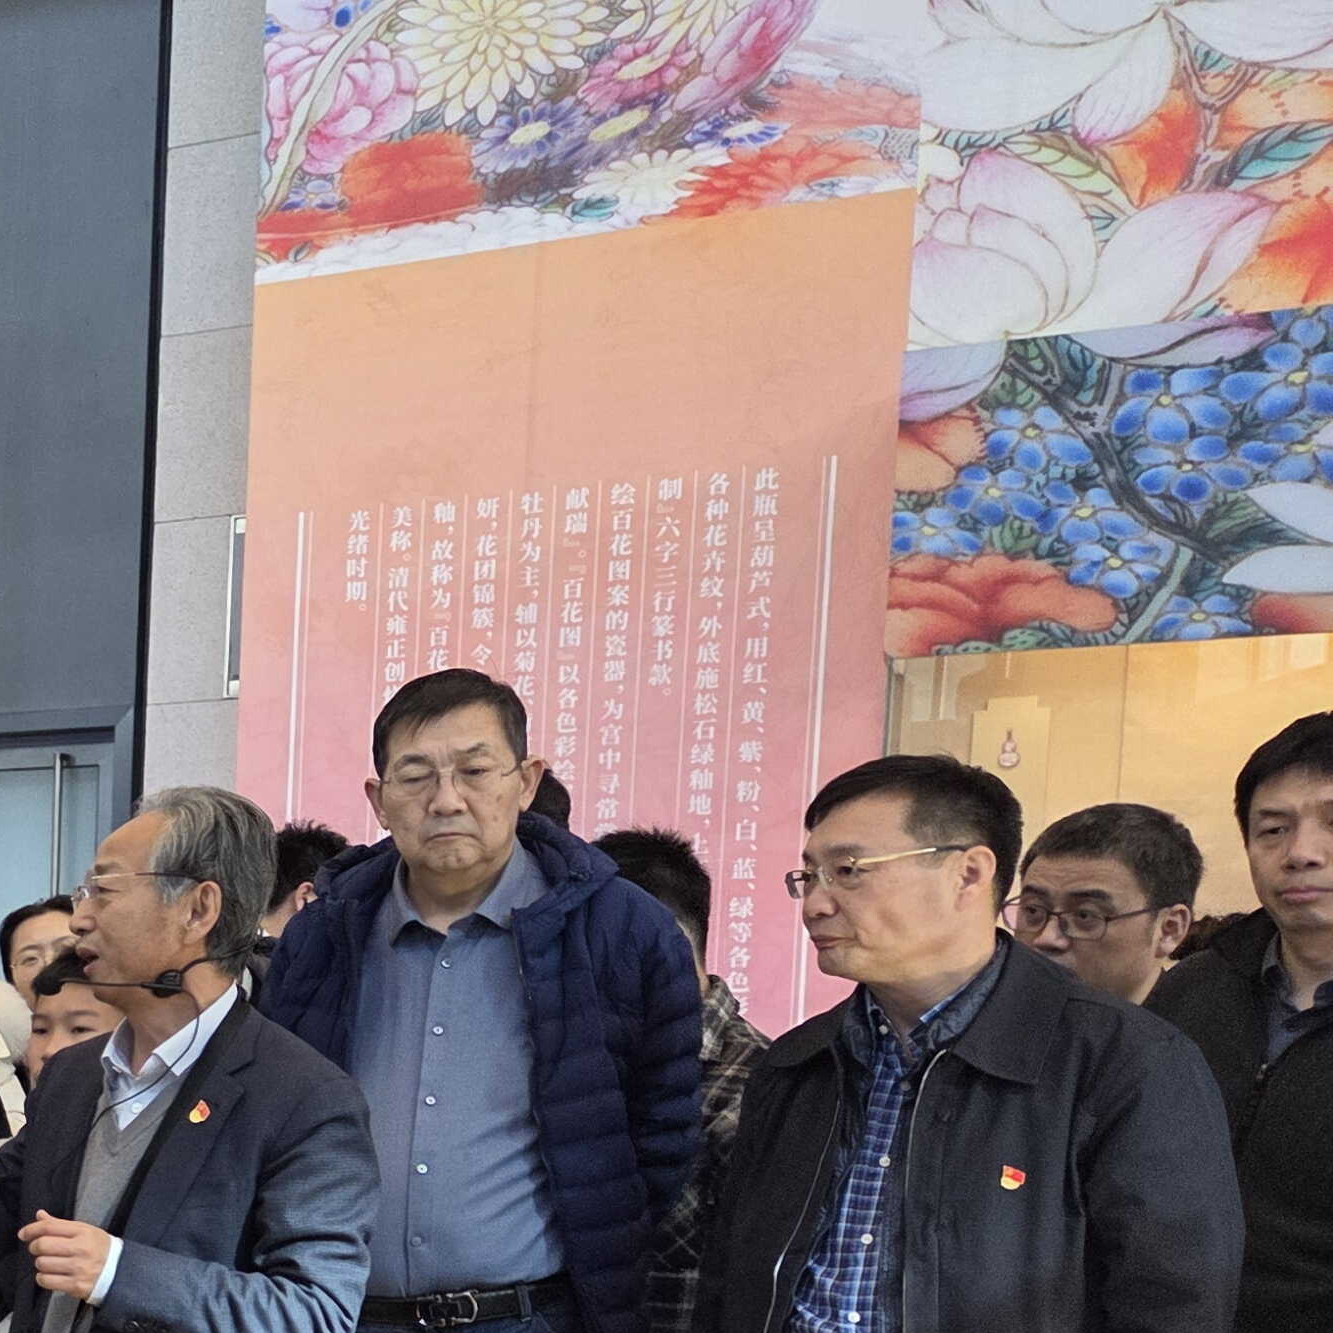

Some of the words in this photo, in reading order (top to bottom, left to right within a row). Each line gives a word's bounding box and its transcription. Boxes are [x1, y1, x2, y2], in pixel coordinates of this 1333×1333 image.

[345, 509, 371, 612] 光绪时期。
[551, 487, 590, 792] 献瑞』。『百花图』以各色彩绘
[687, 472, 730, 866] 各种花卉纹，外底施松石绿釉地，上
[727, 466, 780, 1014] 此瓶呈葫芦式，用红、黄、紫、粉、白、蓝、绿等各色
